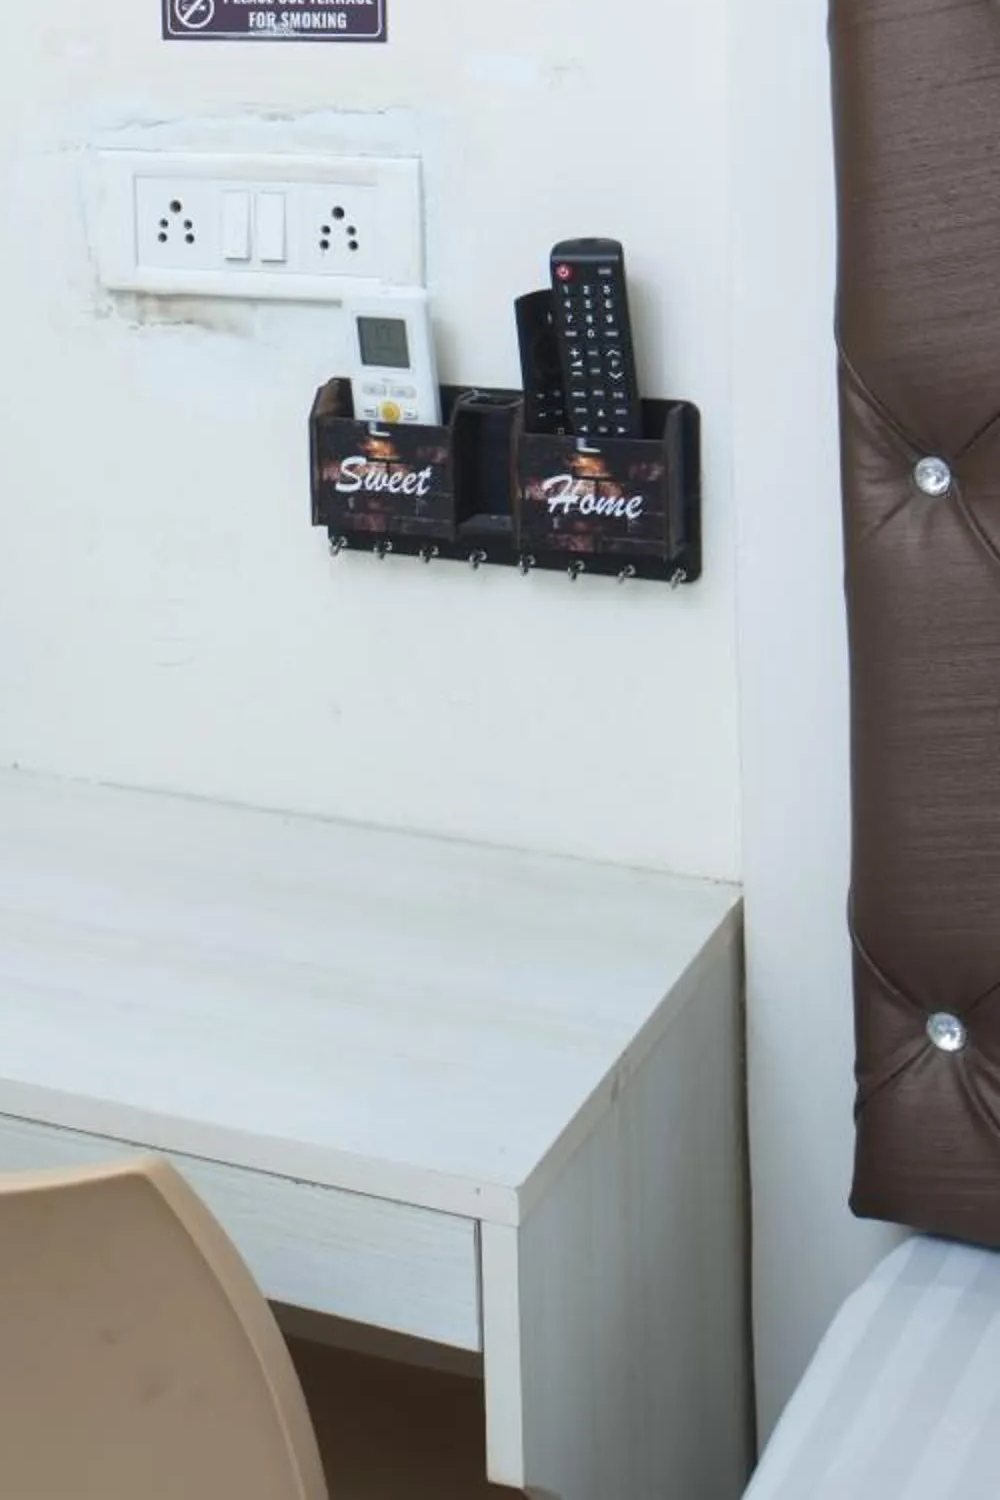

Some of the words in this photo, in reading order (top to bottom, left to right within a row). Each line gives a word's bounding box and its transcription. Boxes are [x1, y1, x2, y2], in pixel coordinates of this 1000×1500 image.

[248, 11, 275, 27] FOR
[281, 11, 347, 29] SMOKING
[335, 455, 433, 496] Sweet
[541, 473, 643, 519] Home
